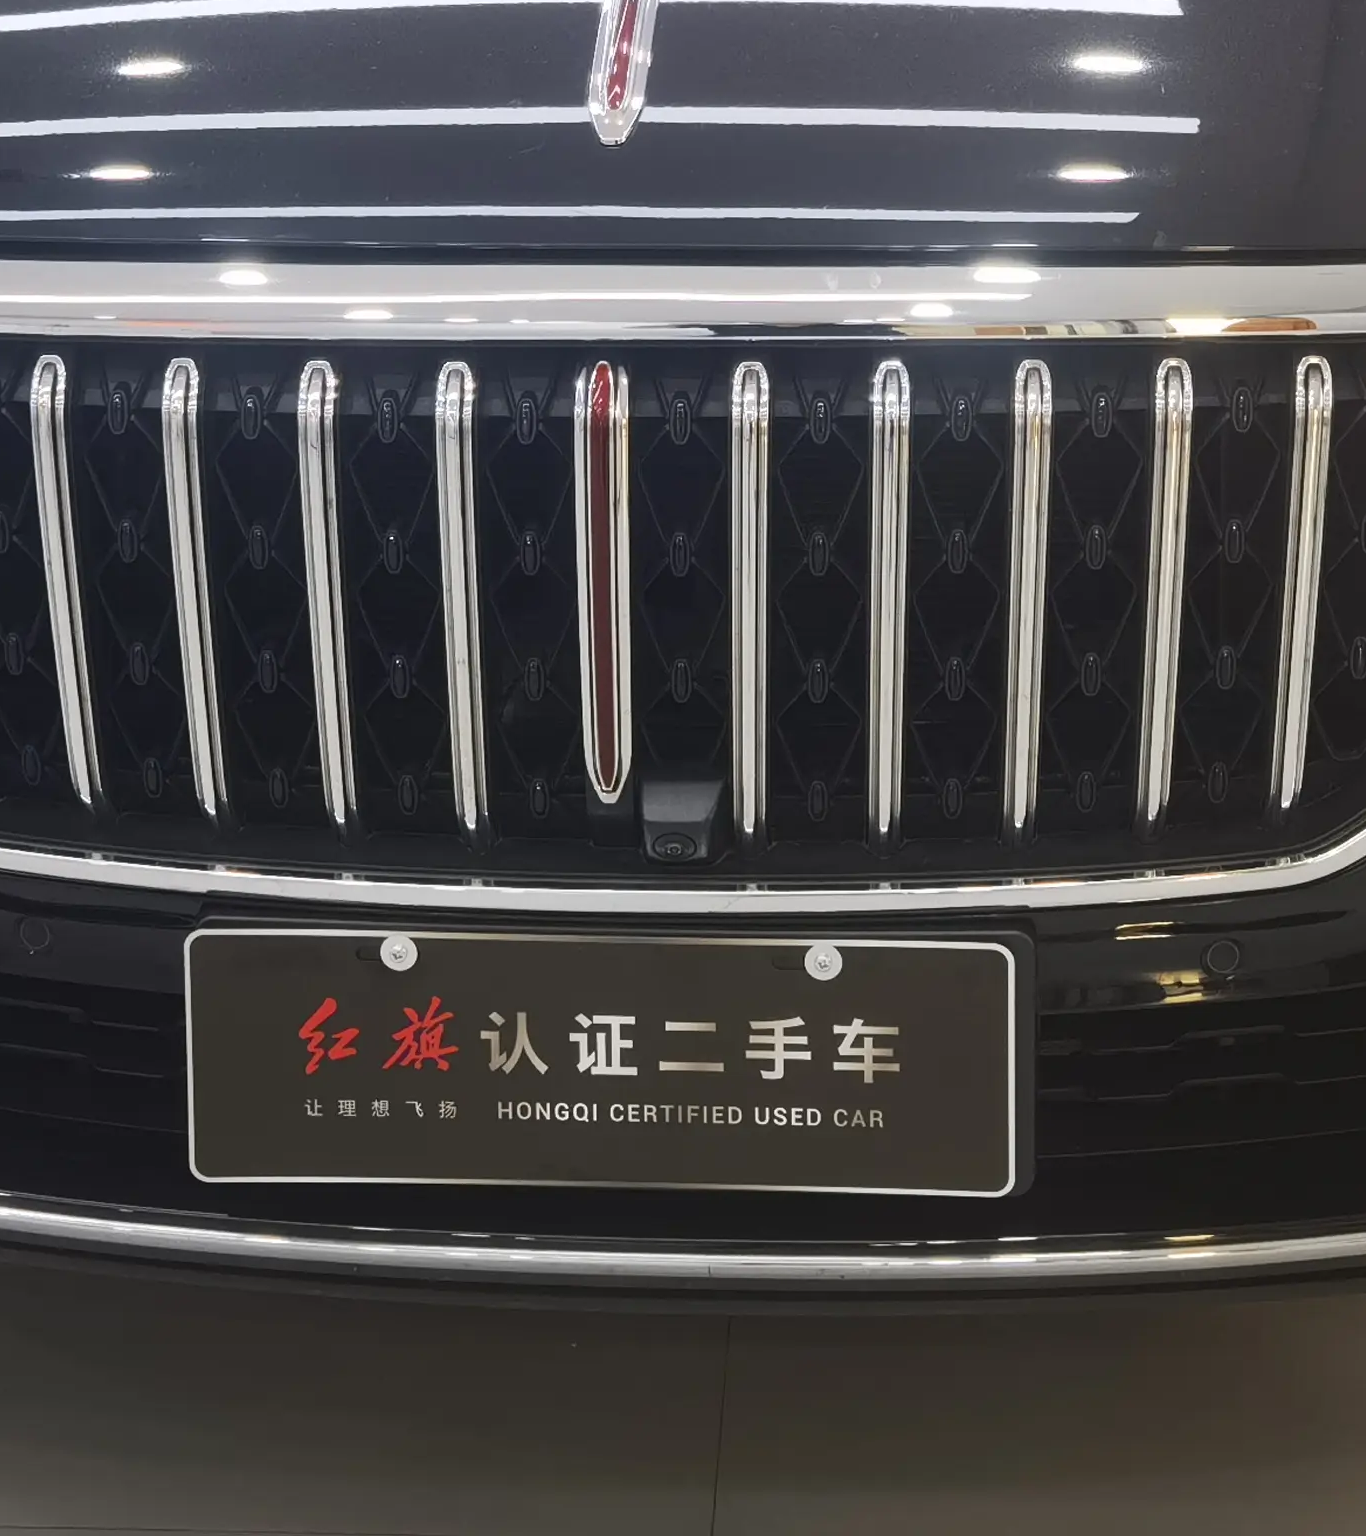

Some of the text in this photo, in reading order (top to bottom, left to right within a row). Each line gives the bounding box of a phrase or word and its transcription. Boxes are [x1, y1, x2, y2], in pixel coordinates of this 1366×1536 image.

[304, 1098, 458, 1120] 让理想飞扬
[496, 1099, 886, 1130] HONGQI CERTIFIED USED CAR
